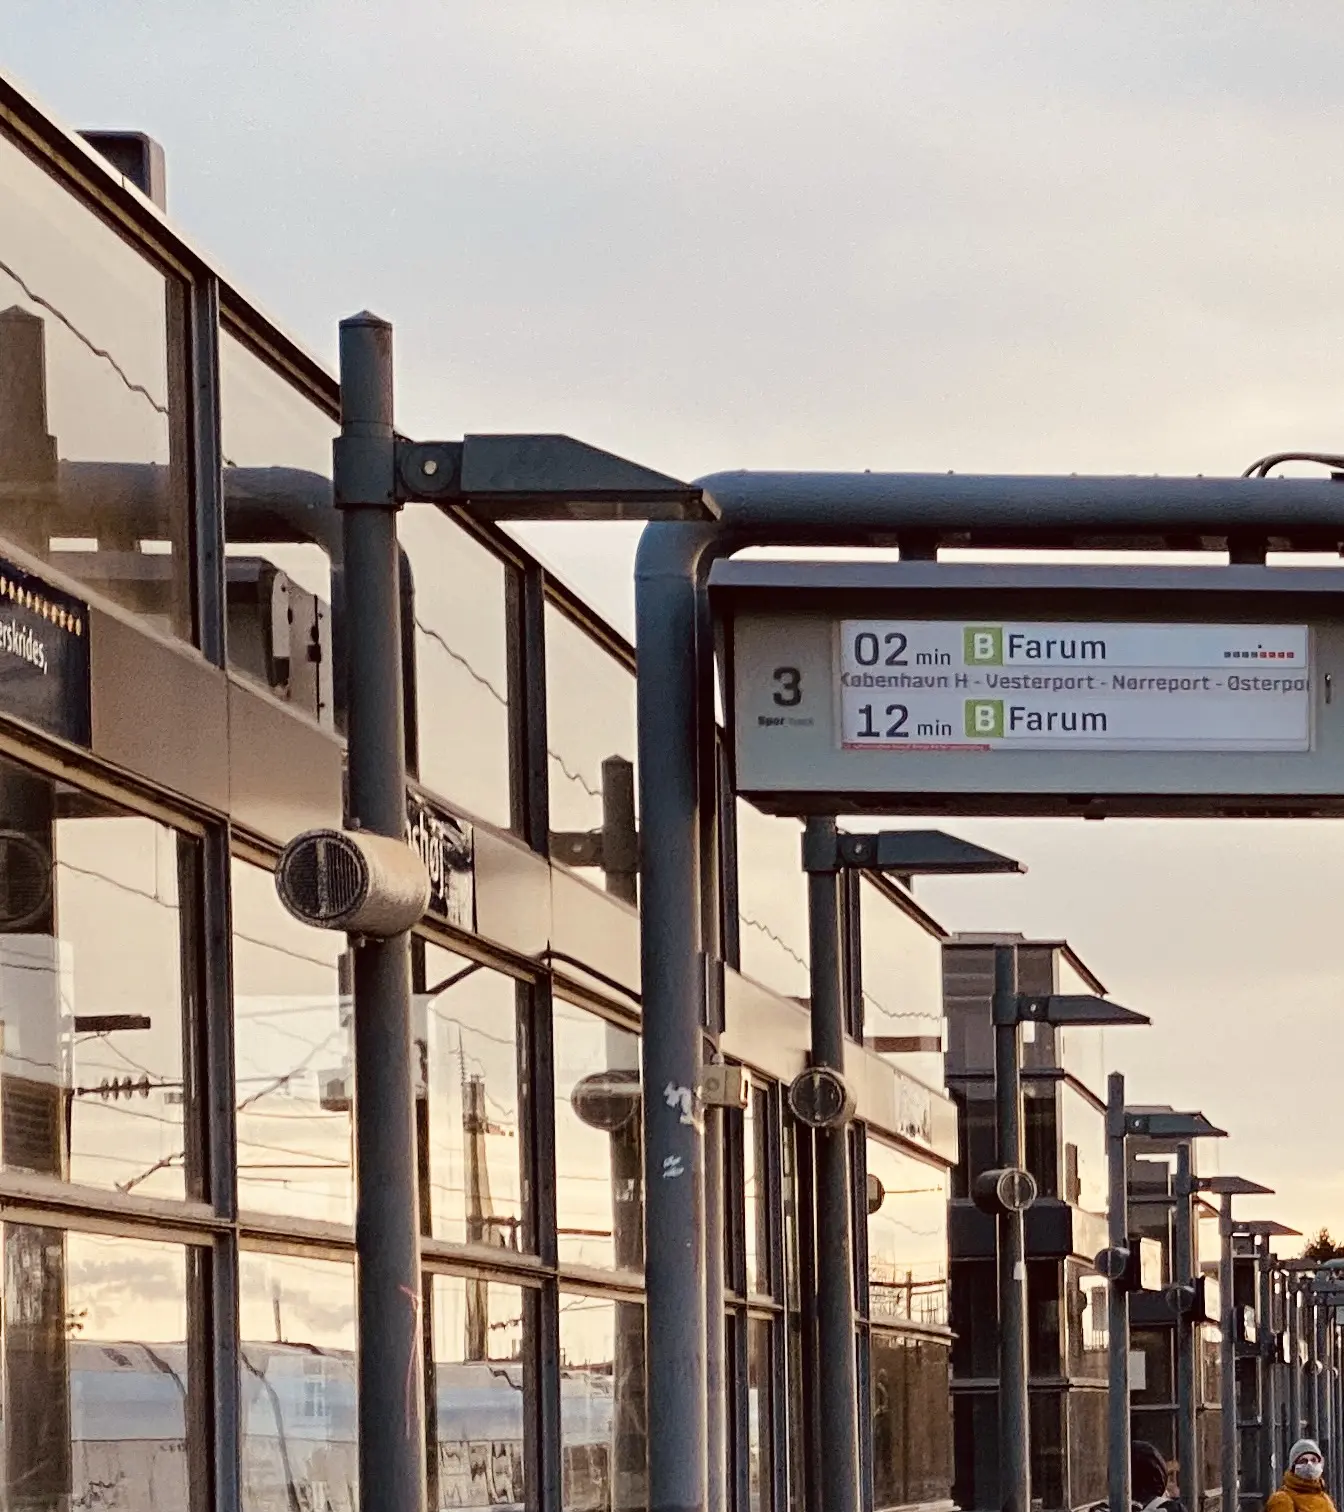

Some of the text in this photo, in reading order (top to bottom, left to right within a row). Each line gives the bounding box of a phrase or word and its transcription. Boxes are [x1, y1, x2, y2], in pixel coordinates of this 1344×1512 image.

[854, 632, 1107, 667] 02 min B Farum
[772, 666, 802, 707] 3
[955, 672, 968, 689] H
[986, 672, 1095, 693] Vesterport
[1112, 674, 1210, 694] Nørreport
[1227, 675, 1309, 694] Østerpo
[857, 703, 1108, 738] 12 min B Farum
[405, 811, 444, 900] shøj
